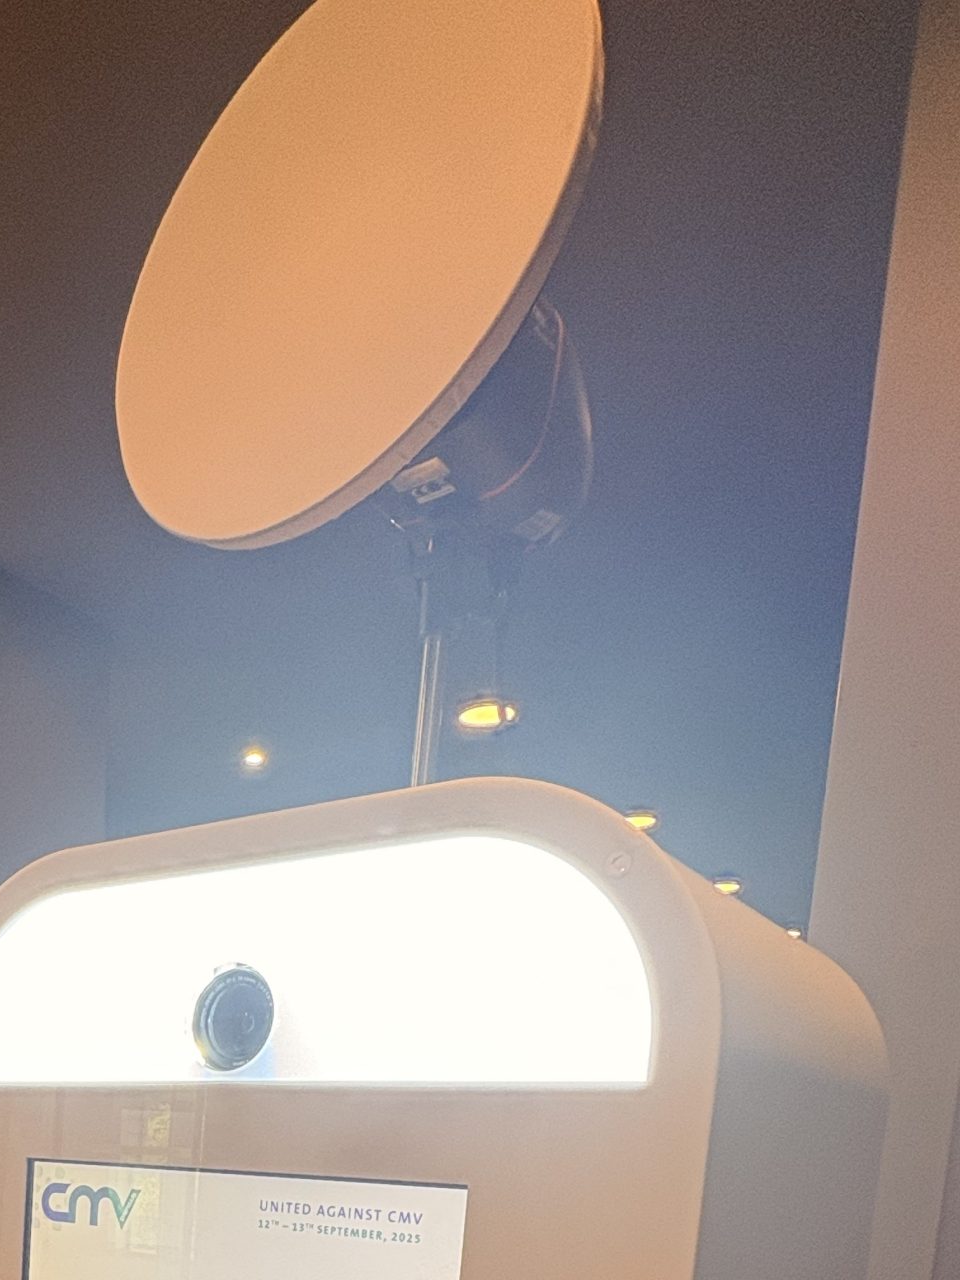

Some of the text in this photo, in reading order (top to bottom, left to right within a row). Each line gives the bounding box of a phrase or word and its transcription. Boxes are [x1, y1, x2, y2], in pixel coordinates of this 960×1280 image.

[259, 1200, 423, 1225] UNITED AGAINST CMV
[317, 1225, 387, 1242] SEPTEMBER,
[391, 1232, 421, 1244] 2025
